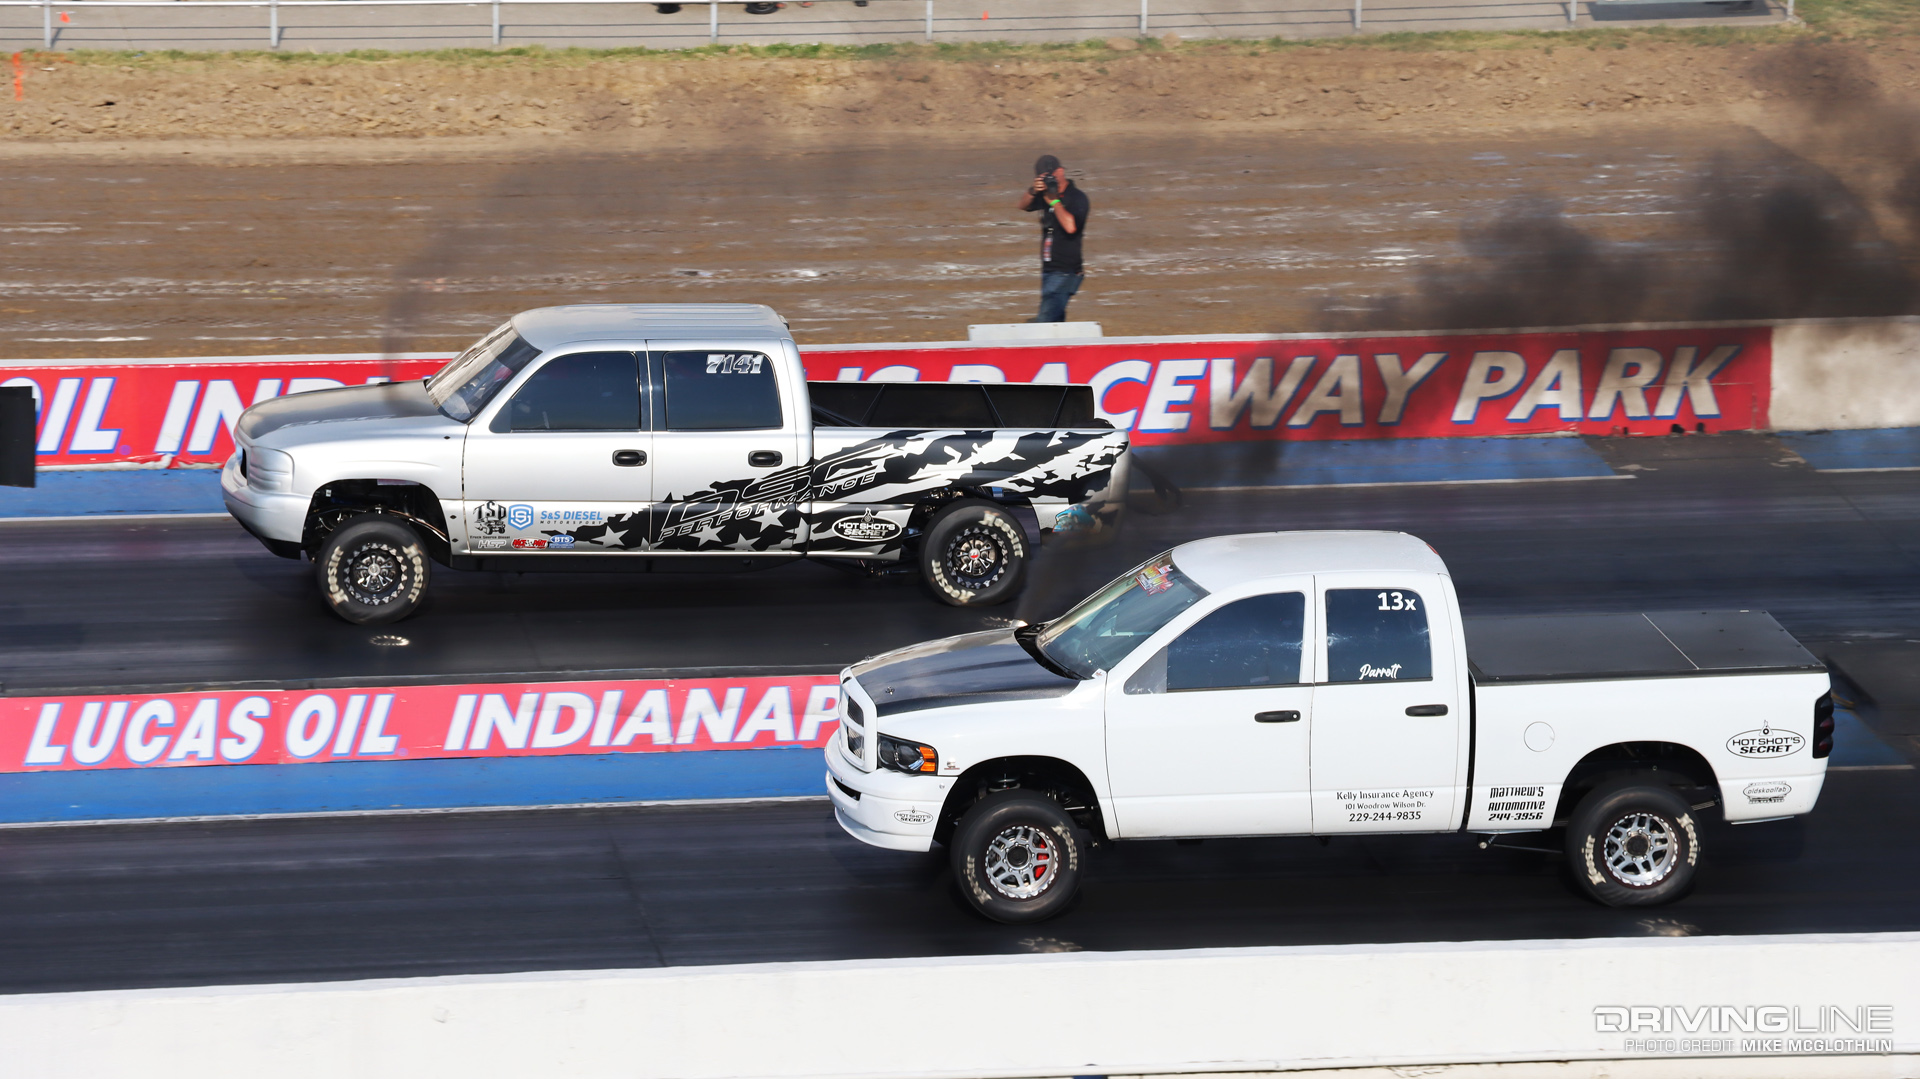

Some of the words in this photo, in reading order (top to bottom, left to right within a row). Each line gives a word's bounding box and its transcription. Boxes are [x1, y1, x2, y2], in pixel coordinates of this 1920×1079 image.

[706, 354, 764, 373] 7141
[1451, 345, 1742, 425] PARK
[657, 472, 877, 542] PERFORMANCE
[540, 510, 561, 521] S&S
[563, 511, 603, 521] DIESEL
[843, 529, 888, 537] SECRET
[1377, 591, 1417, 611] 13x
[1358, 663, 1402, 680] Parrott
[23, 696, 272, 766] LUCAS
[285, 693, 401, 760] OIL
[1732, 739, 1756, 747] HOT
[1758, 736, 1801, 746] SHOT'S
[1739, 744, 1792, 754] SECRET
[1336, 791, 1357, 801] Kelly
[1359, 790, 1400, 800] Insurance
[1402, 789, 1435, 800] Agency
[1357, 802, 1391, 810] Woodrow
[1349, 811, 1421, 822] 229-244-9835
[1488, 812, 1544, 821] 244-3956
